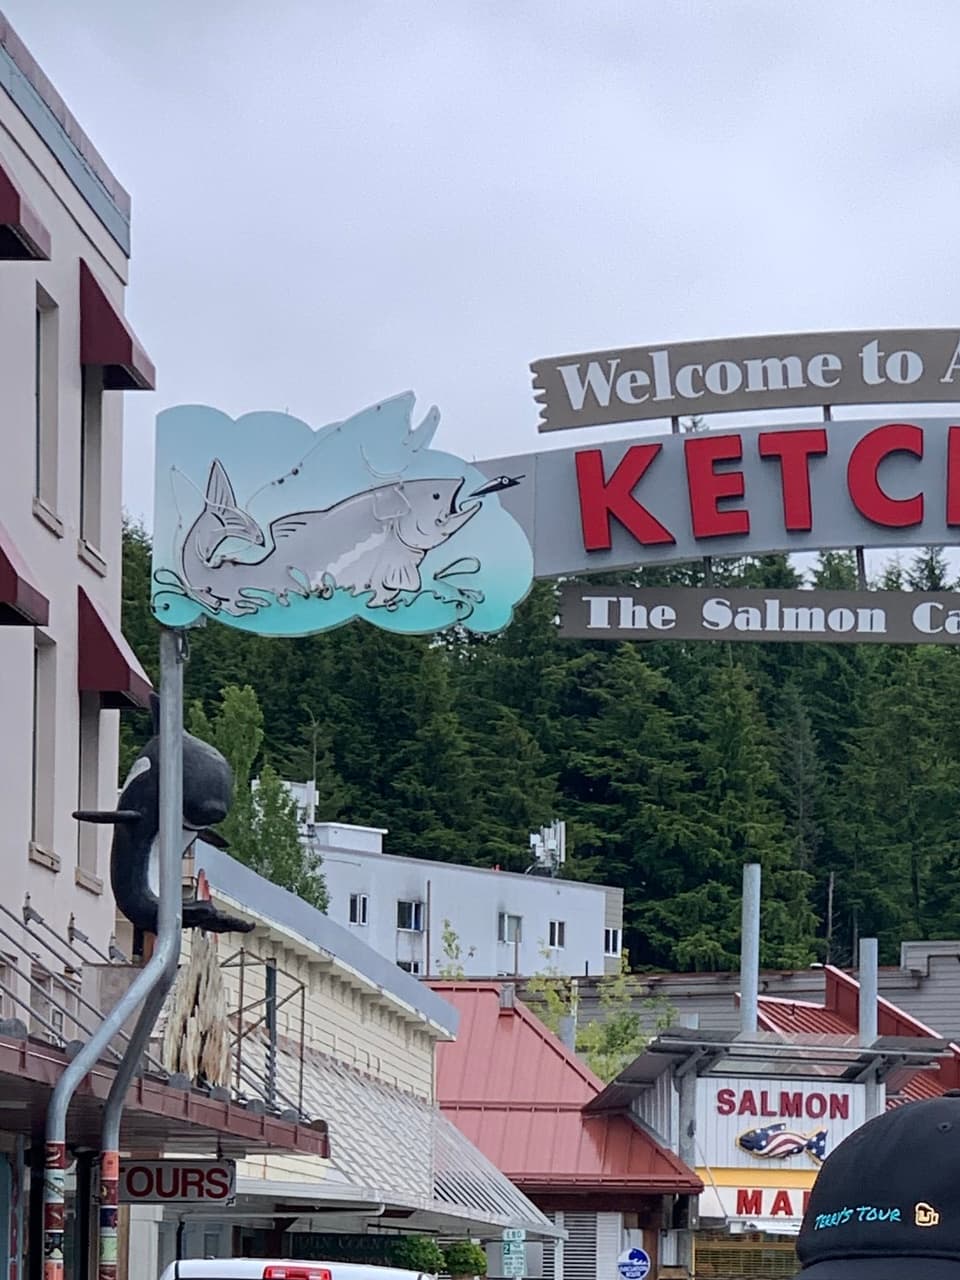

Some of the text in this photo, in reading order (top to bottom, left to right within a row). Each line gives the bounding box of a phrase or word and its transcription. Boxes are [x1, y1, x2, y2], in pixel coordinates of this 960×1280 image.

[557, 350, 842, 411] Welcome
[858, 338, 924, 385] to
[582, 597, 677, 630] The
[702, 598, 887, 634] Salmon
[717, 1088, 849, 1120] SALMON
[856, 1205, 901, 1222] TOUR
